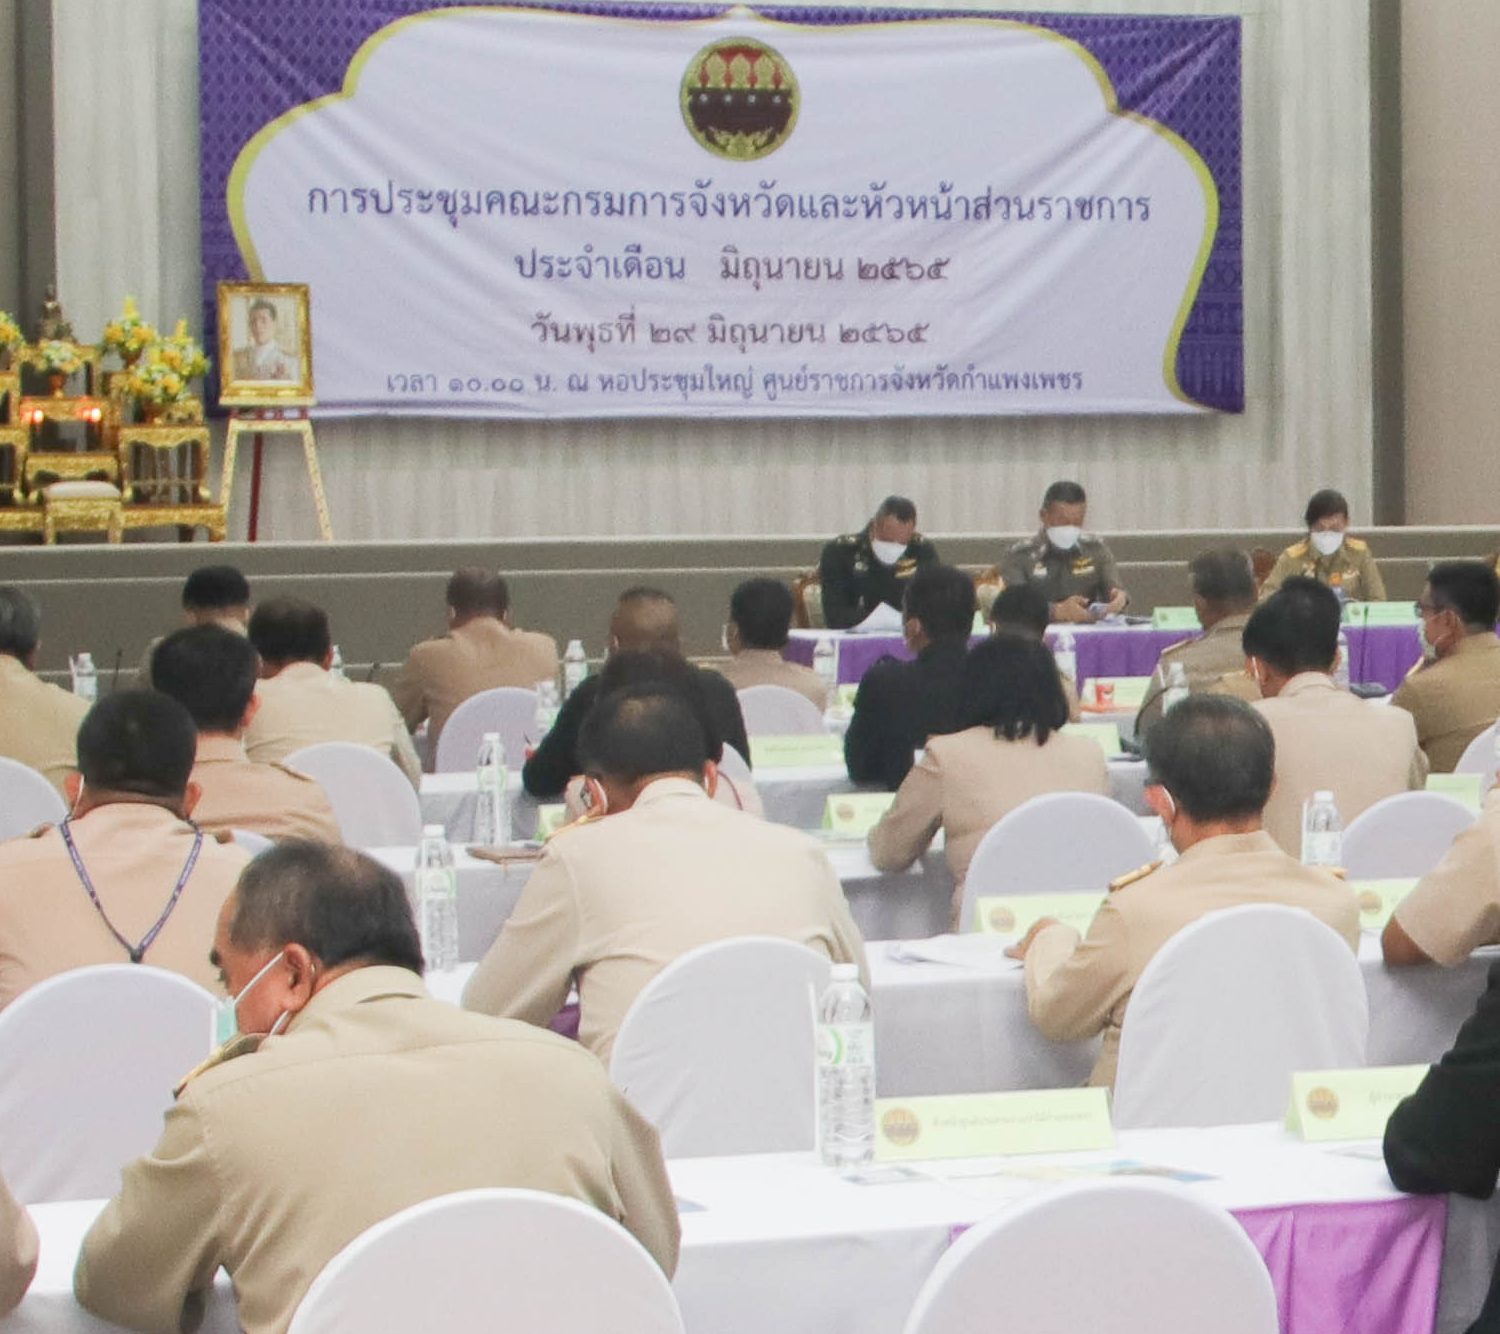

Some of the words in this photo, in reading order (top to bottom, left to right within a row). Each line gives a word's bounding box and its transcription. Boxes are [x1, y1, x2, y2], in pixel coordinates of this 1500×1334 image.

[307, 178, 1152, 228] การประชุมคณะกรมการจังหวัดและหัวหน้าส่วนราชการ
[514, 243, 686, 280] ประจำเดือน
[719, 245, 845, 290] มิถุนายน
[856, 255, 951, 282] ๒๕๖๕
[530, 304, 637, 353] วันพุธที่
[649, 320, 697, 344] ๒๙
[707, 313, 826, 354] มิถุนายน
[839, 319, 930, 345] ๒๕๖๕
[386, 369, 438, 394] เวลา
[448, 374, 524, 393] ๑๐.๐๐
[535, 372, 558, 393] น.
[567, 373, 588, 394] ณ
[598, 363, 754, 400] หอประชุมใหญ่
[762, 363, 1084, 401] ศูนย์ราชการจังหวัดกำแพงเพชร
